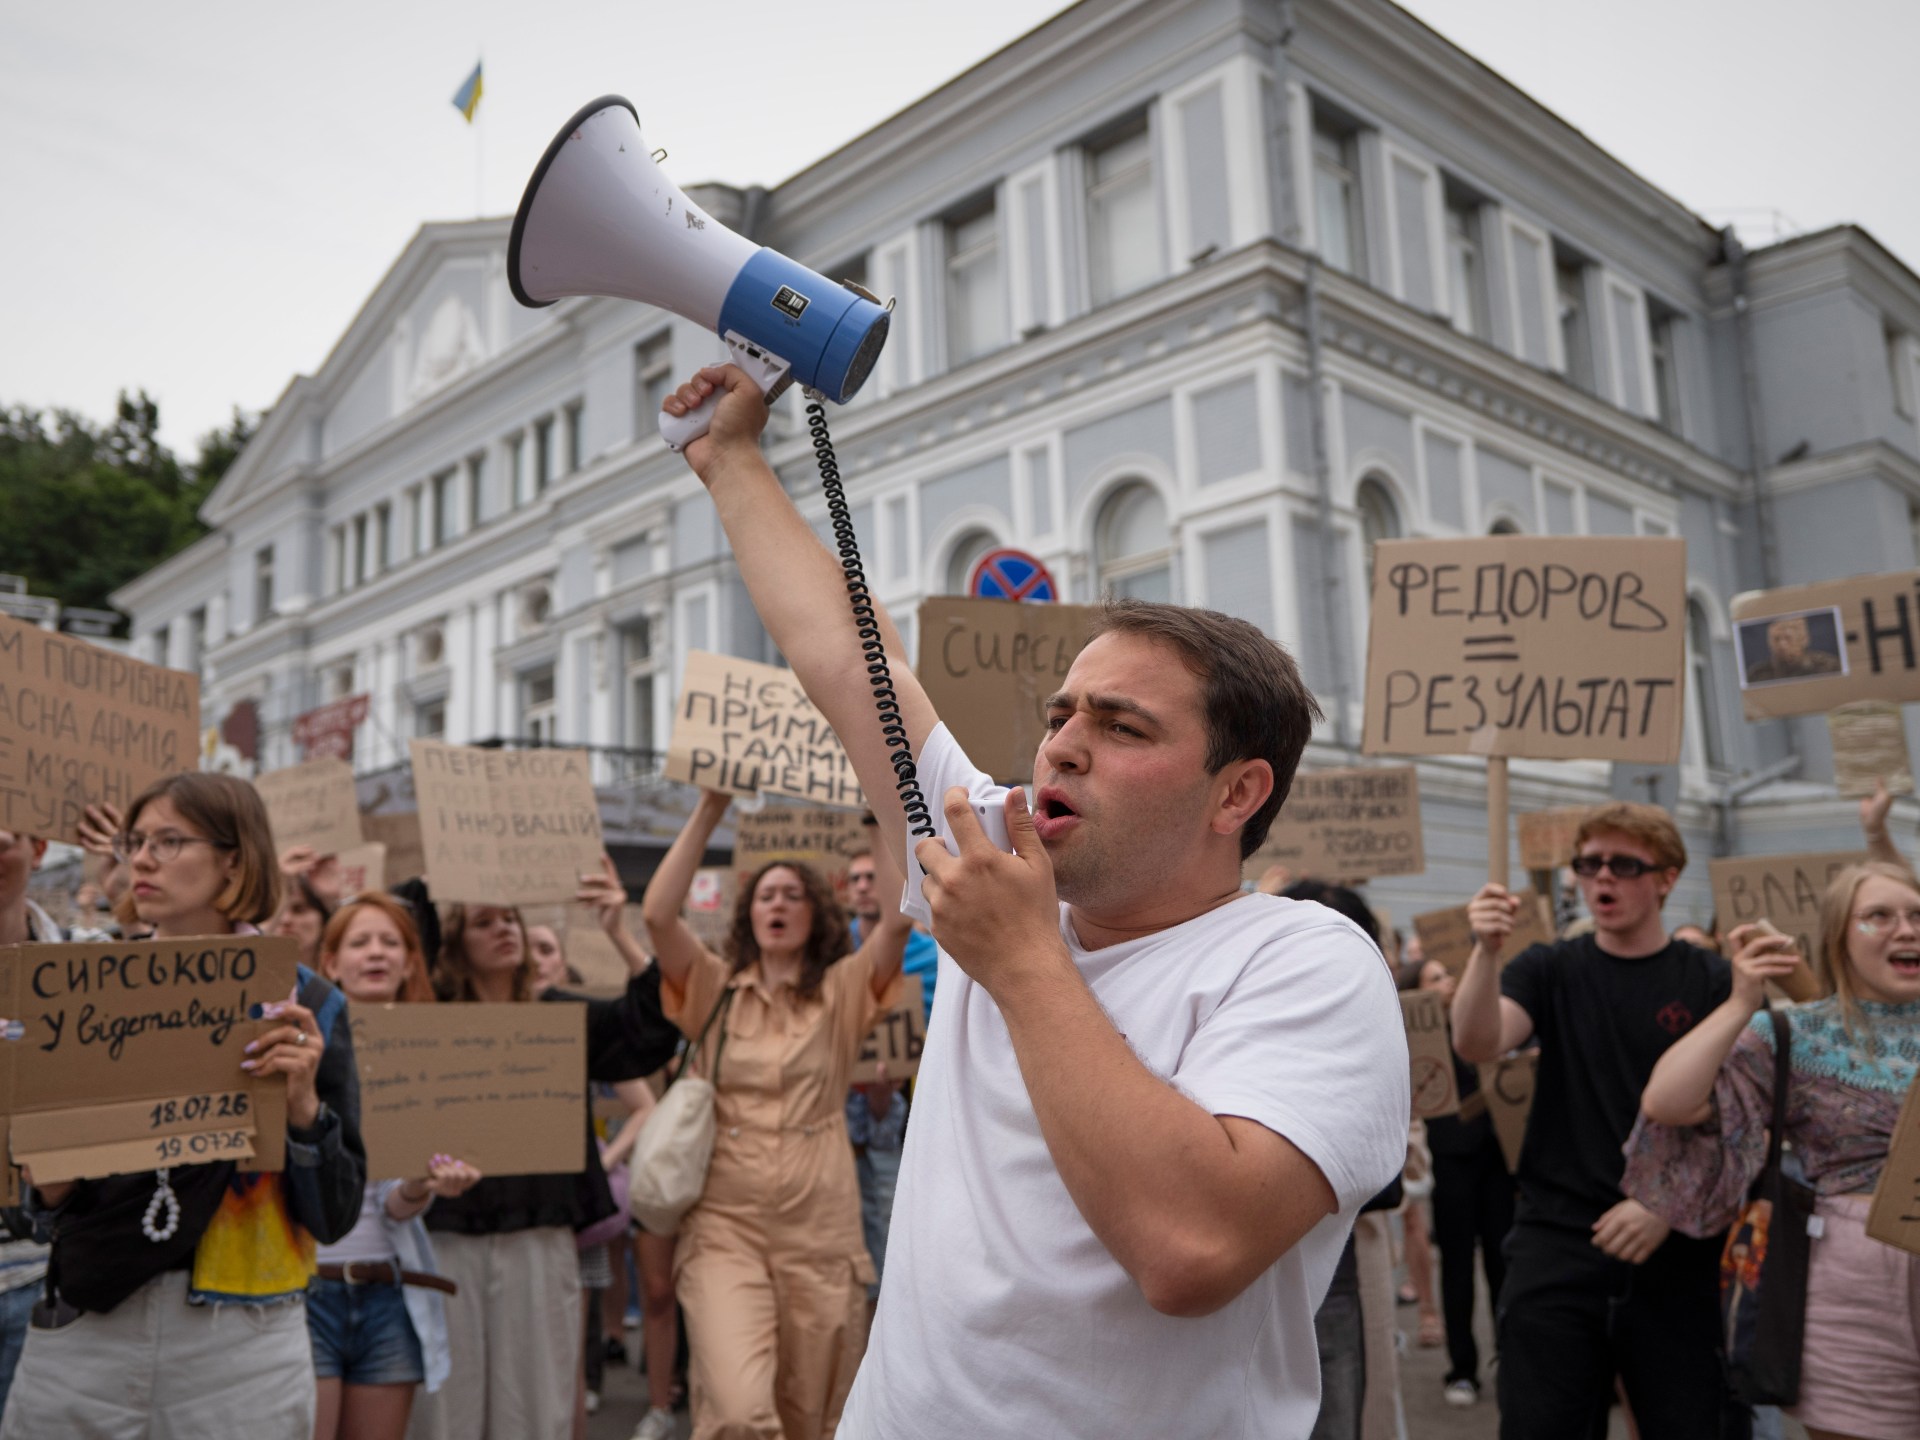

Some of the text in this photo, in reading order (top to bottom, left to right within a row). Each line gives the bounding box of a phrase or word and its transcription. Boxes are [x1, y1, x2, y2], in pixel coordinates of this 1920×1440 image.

[1388, 563, 1668, 632] ФЕДОРОВ
[1463, 635, 1520, 661] =
[44, 637, 191, 720] ПОТРІБНА
[1383, 670, 1676, 743] РЕЗУЛЬТАТ
[424, 748, 583, 782] ПЕРЕМОГА
[438, 803, 600, 839] ІННОВАЦІЙ
[32, 948, 257, 1000] СИРСЬКОГО
